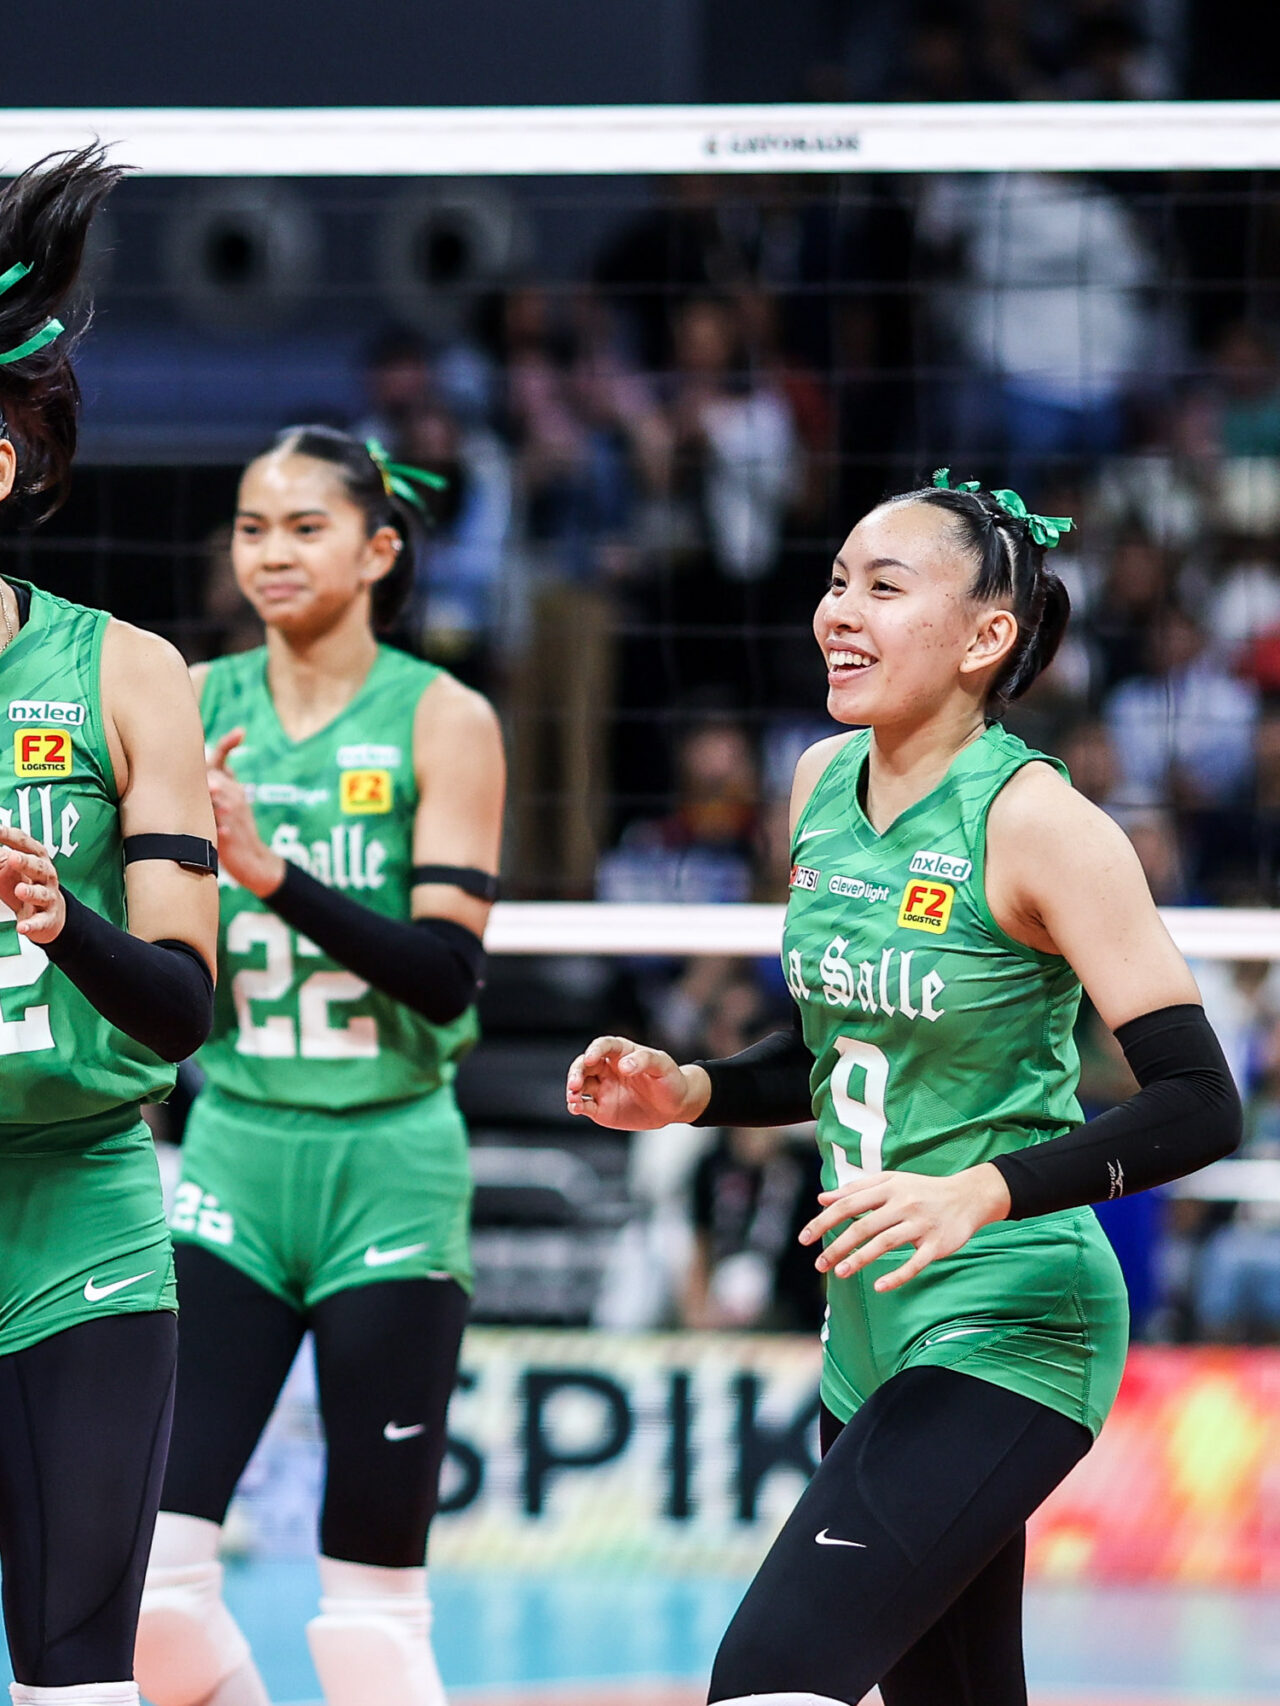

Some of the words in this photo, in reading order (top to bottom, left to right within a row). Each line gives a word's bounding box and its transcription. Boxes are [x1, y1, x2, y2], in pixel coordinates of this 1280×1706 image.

[11, 703, 81, 723] nxled
[22, 735, 65, 762] F2
[22, 763, 65, 771] LOGISTICS
[911, 856, 969, 878] nxled
[905, 886, 946, 918] F2
[903, 913, 942, 927] LOGISTICS
[227, 911, 380, 1059] 22
[788, 947, 811, 1001] a
[820, 935, 946, 1023] Salle
[830, 1036, 890, 1188] 9
